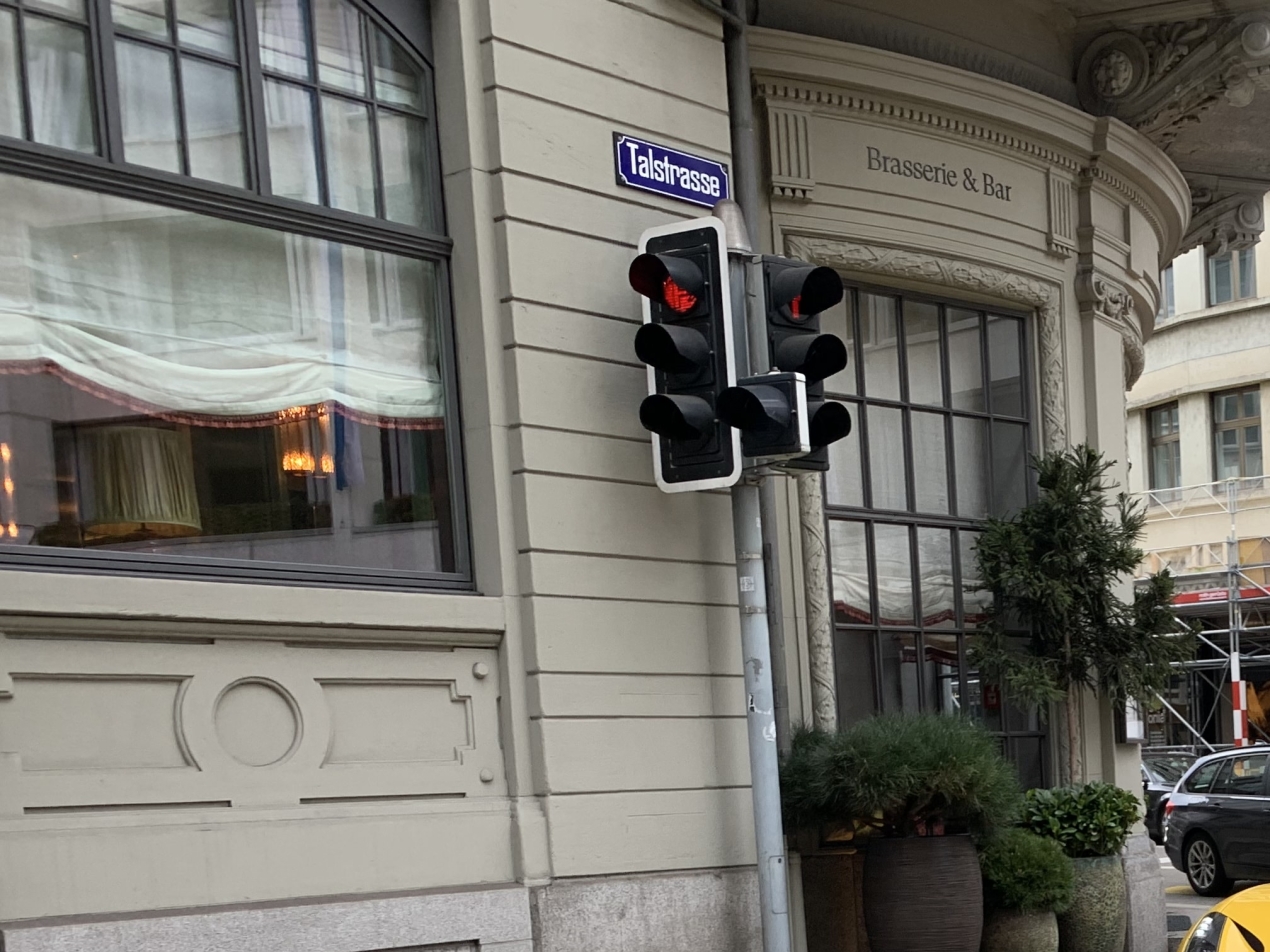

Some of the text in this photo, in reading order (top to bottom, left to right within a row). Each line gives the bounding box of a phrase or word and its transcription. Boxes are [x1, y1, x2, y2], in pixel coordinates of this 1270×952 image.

[626, 142, 720, 198] Talstrasse
[866, 146, 1012, 202] Brasserie & Bar
